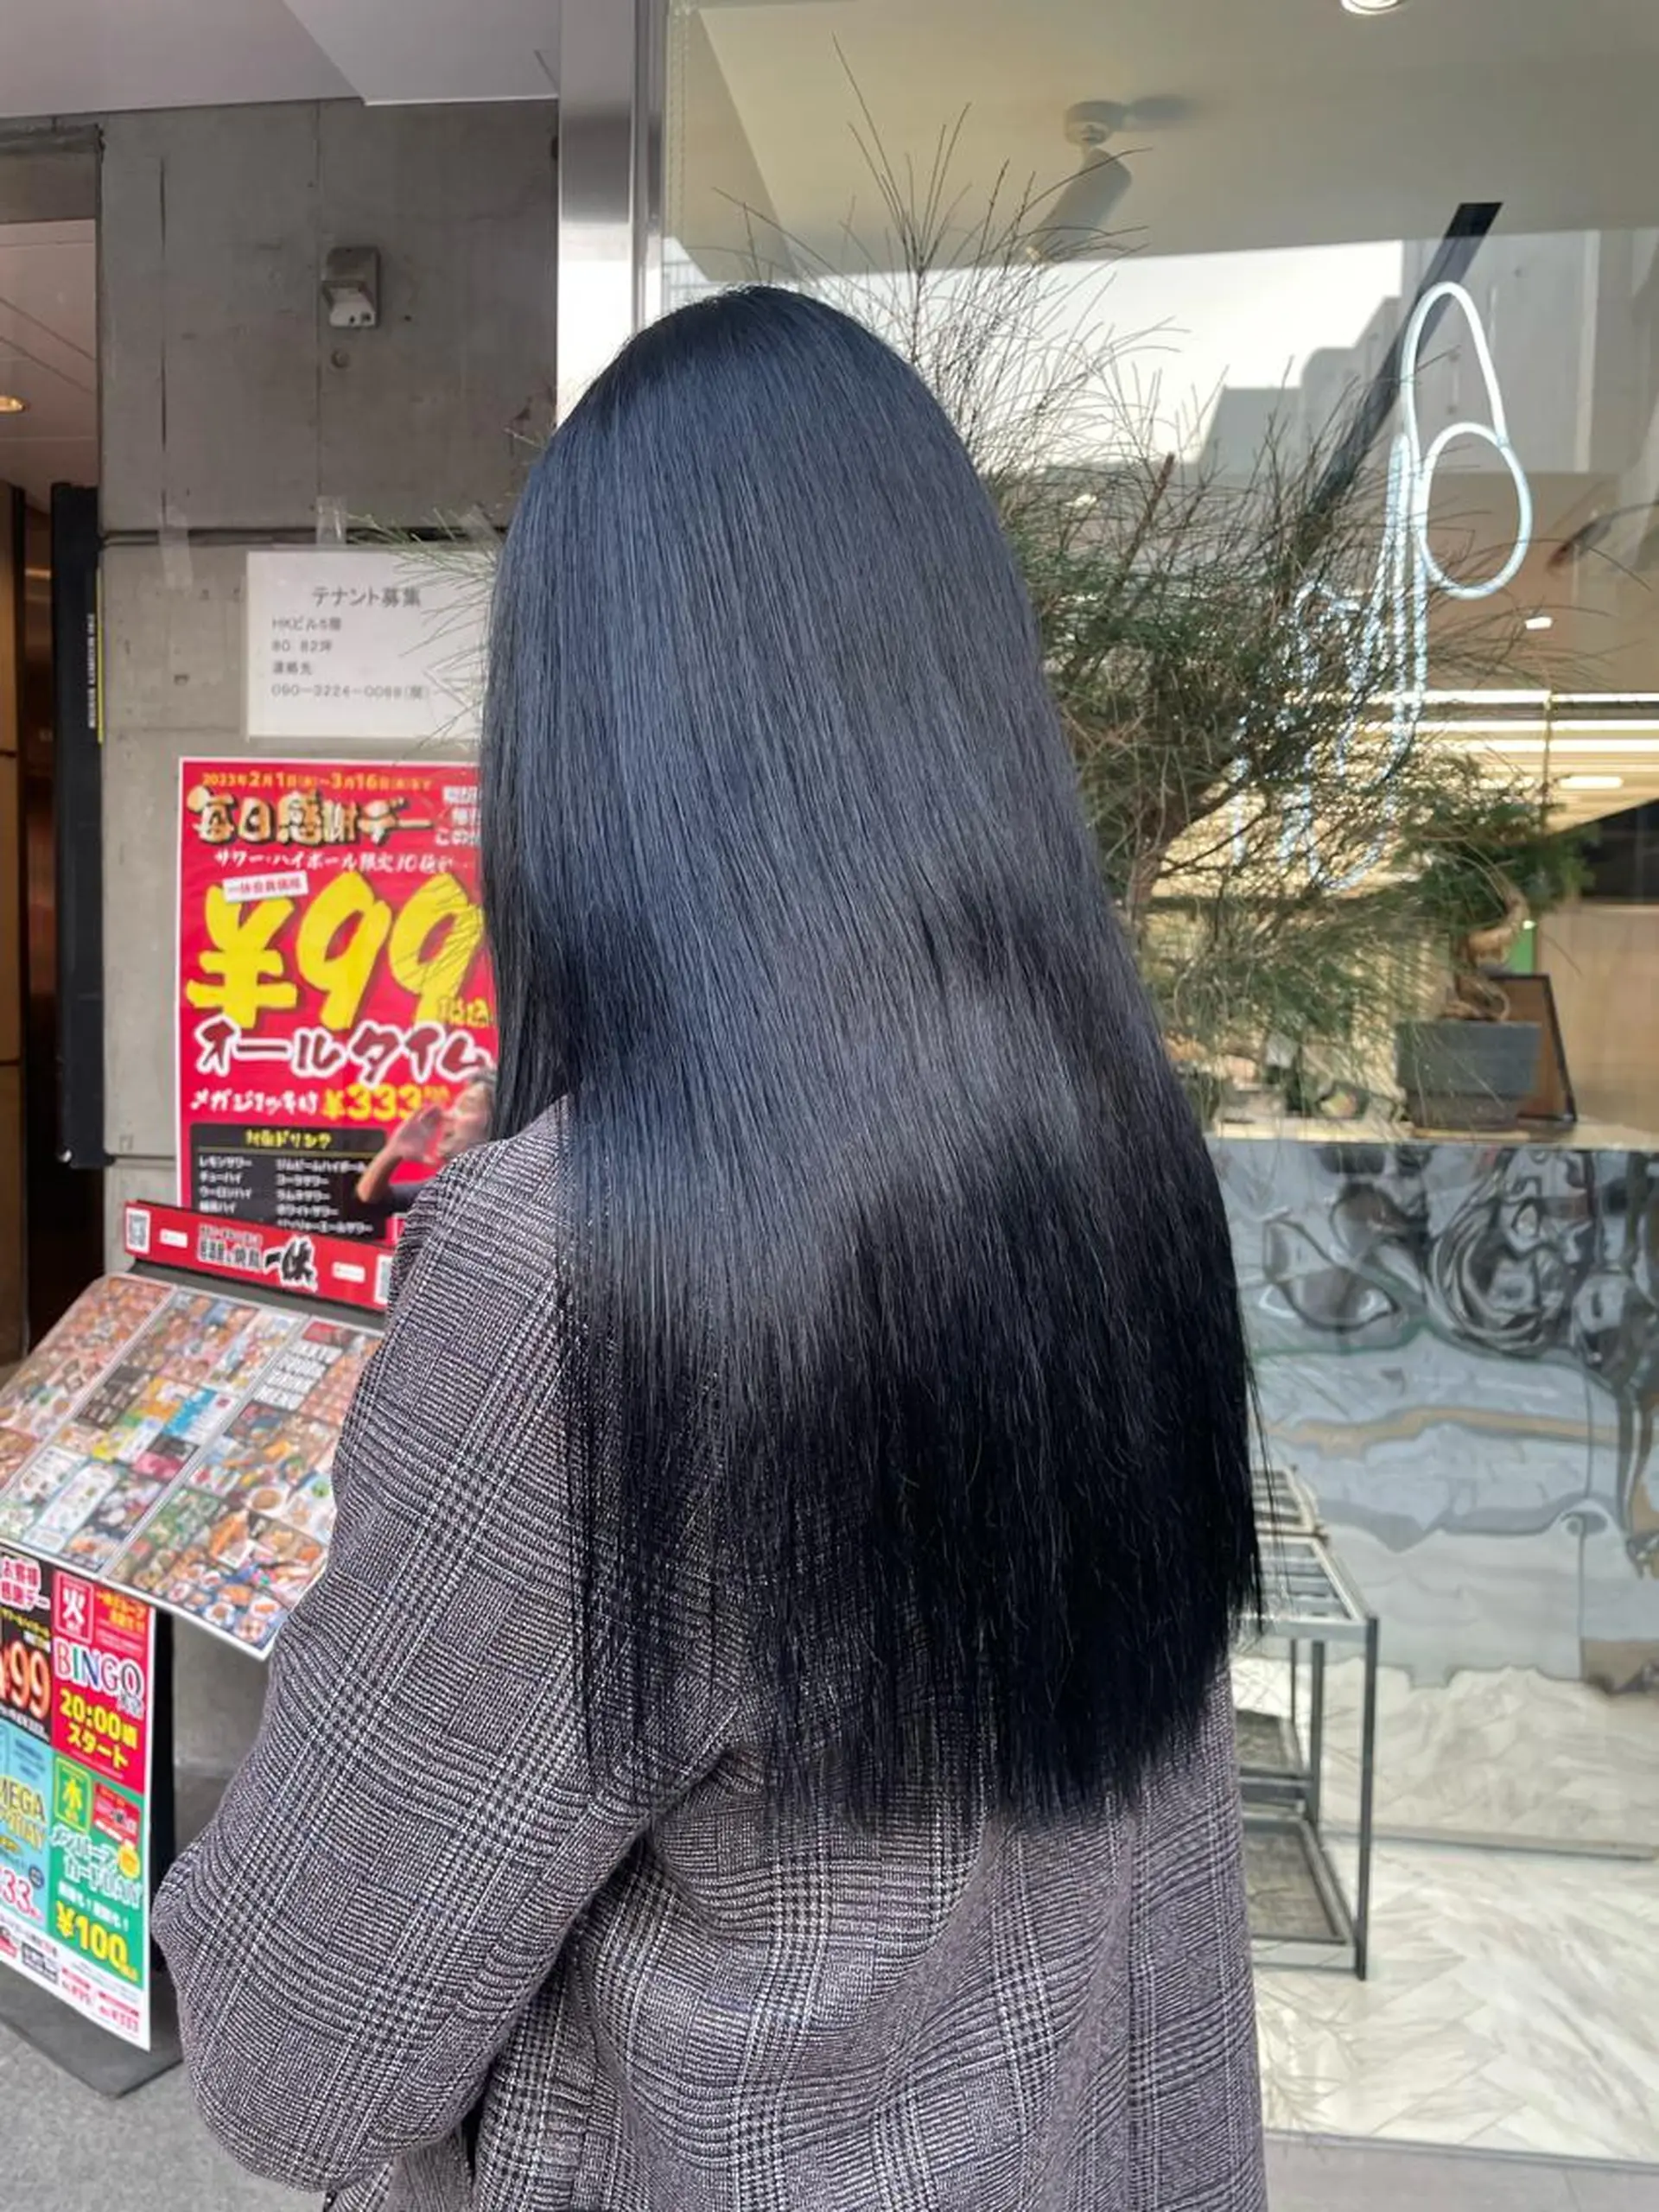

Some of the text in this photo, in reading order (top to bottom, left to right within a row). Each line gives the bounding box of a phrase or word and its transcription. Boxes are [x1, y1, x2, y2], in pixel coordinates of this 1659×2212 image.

[312, 585, 421, 607] テナント募集
[186, 870, 484, 1029] ¥99
[62, 1587, 86, 1627] 火
[54, 1637, 145, 1700] BINGO
[67, 1722, 129, 1769] スタート
[55, 1899, 128, 1974] ¥100
